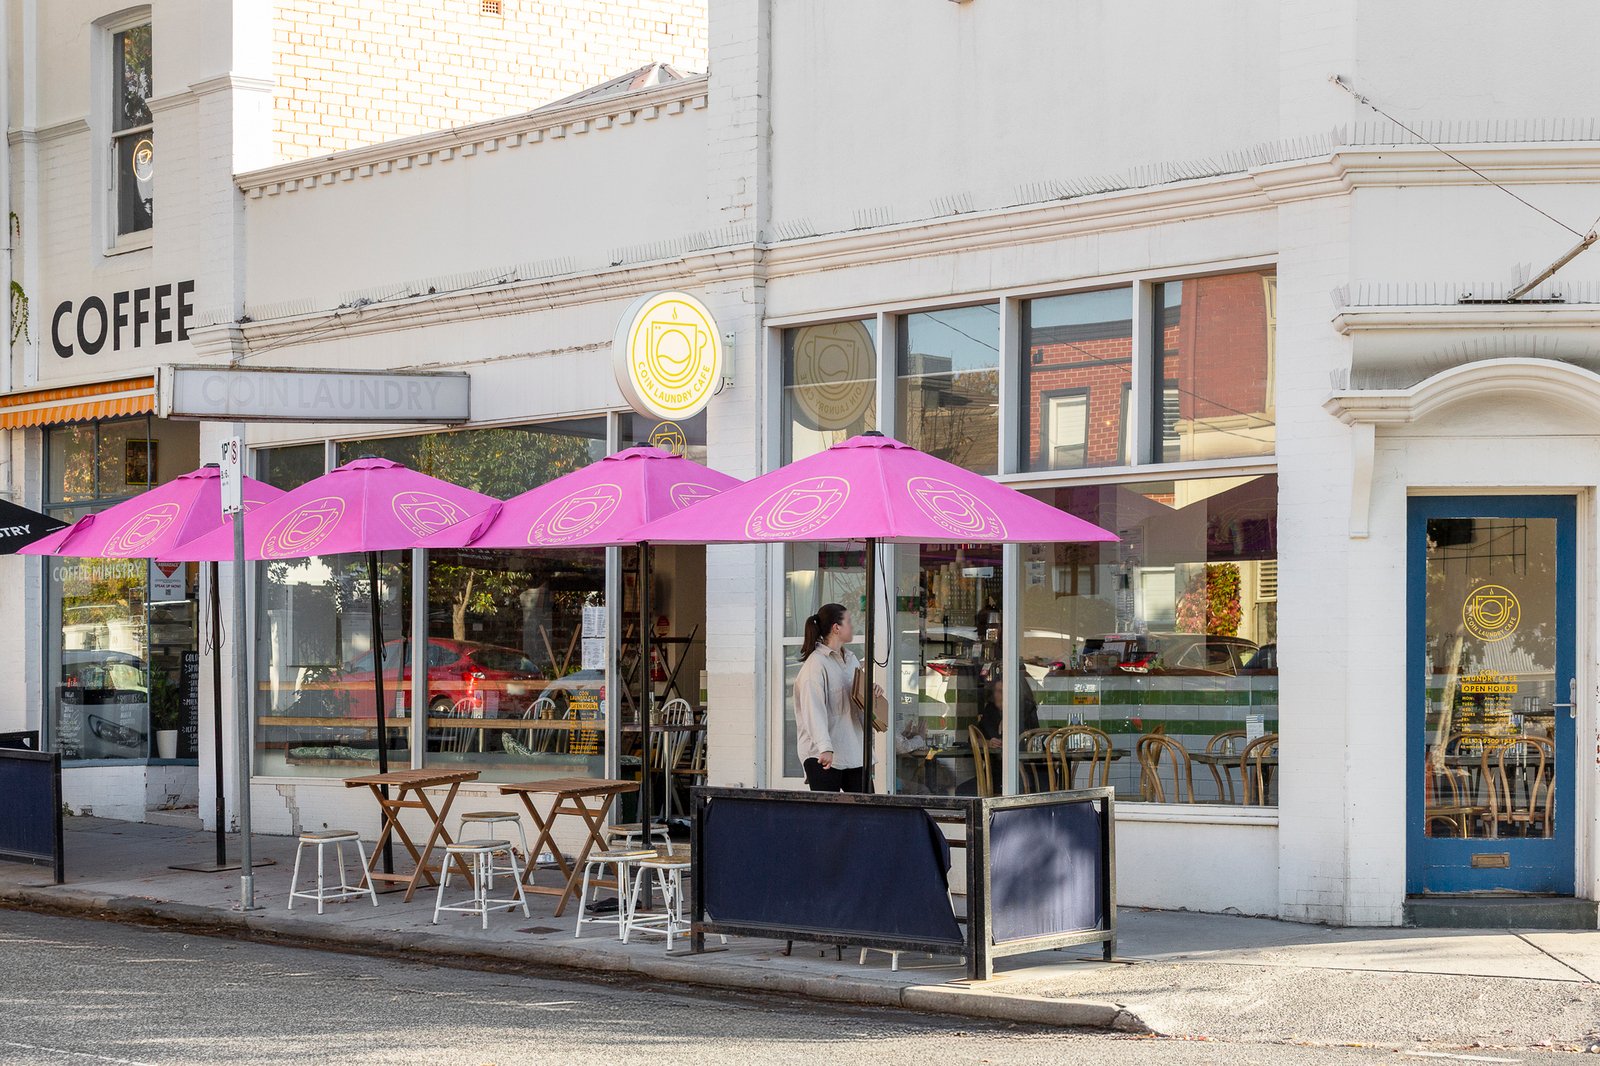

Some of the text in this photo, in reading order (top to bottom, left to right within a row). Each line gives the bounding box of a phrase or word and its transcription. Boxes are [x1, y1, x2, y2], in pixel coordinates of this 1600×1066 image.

[52, 280, 195, 358] COFFEE
[202, 375, 443, 410] COIN LAUNDRY
[638, 361, 710, 404] COIN LAUNDRY CAFE
[53, 561, 142, 582] COFFEE MINISTRY
[1504, 616, 1517, 632] CAFE
